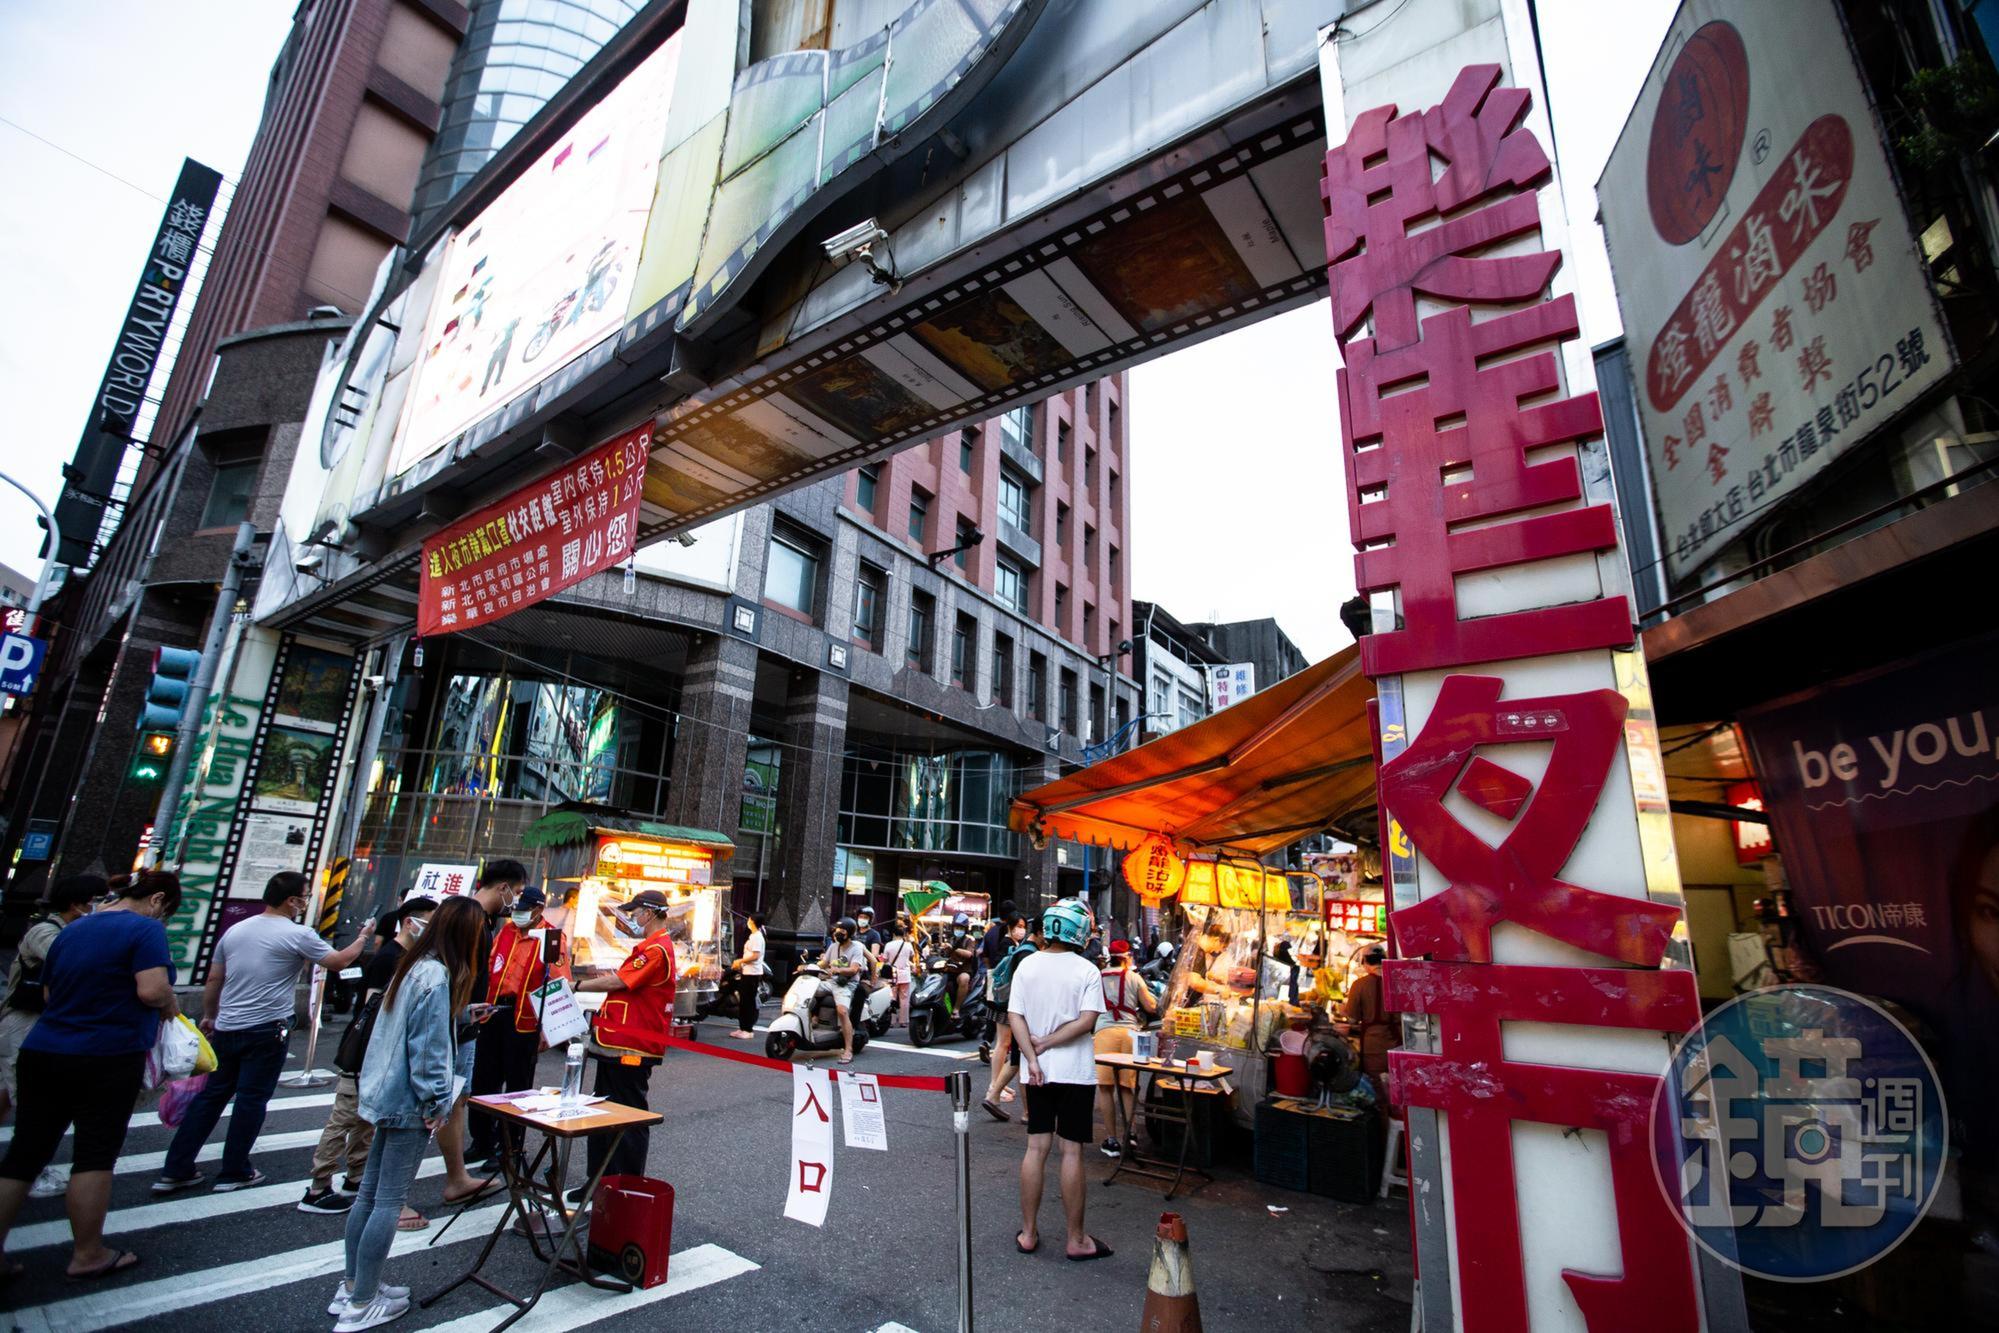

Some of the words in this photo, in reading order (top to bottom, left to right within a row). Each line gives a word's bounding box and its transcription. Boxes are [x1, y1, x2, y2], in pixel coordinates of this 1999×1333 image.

[101, 257, 185, 424] PRTYWORLD
[0, 634, 34, 678] P
[205, 733, 254, 786] Hua
[1792, 740, 1859, 788] be
[184, 793, 240, 864] Night
[797, 1082, 829, 1194] 入口
